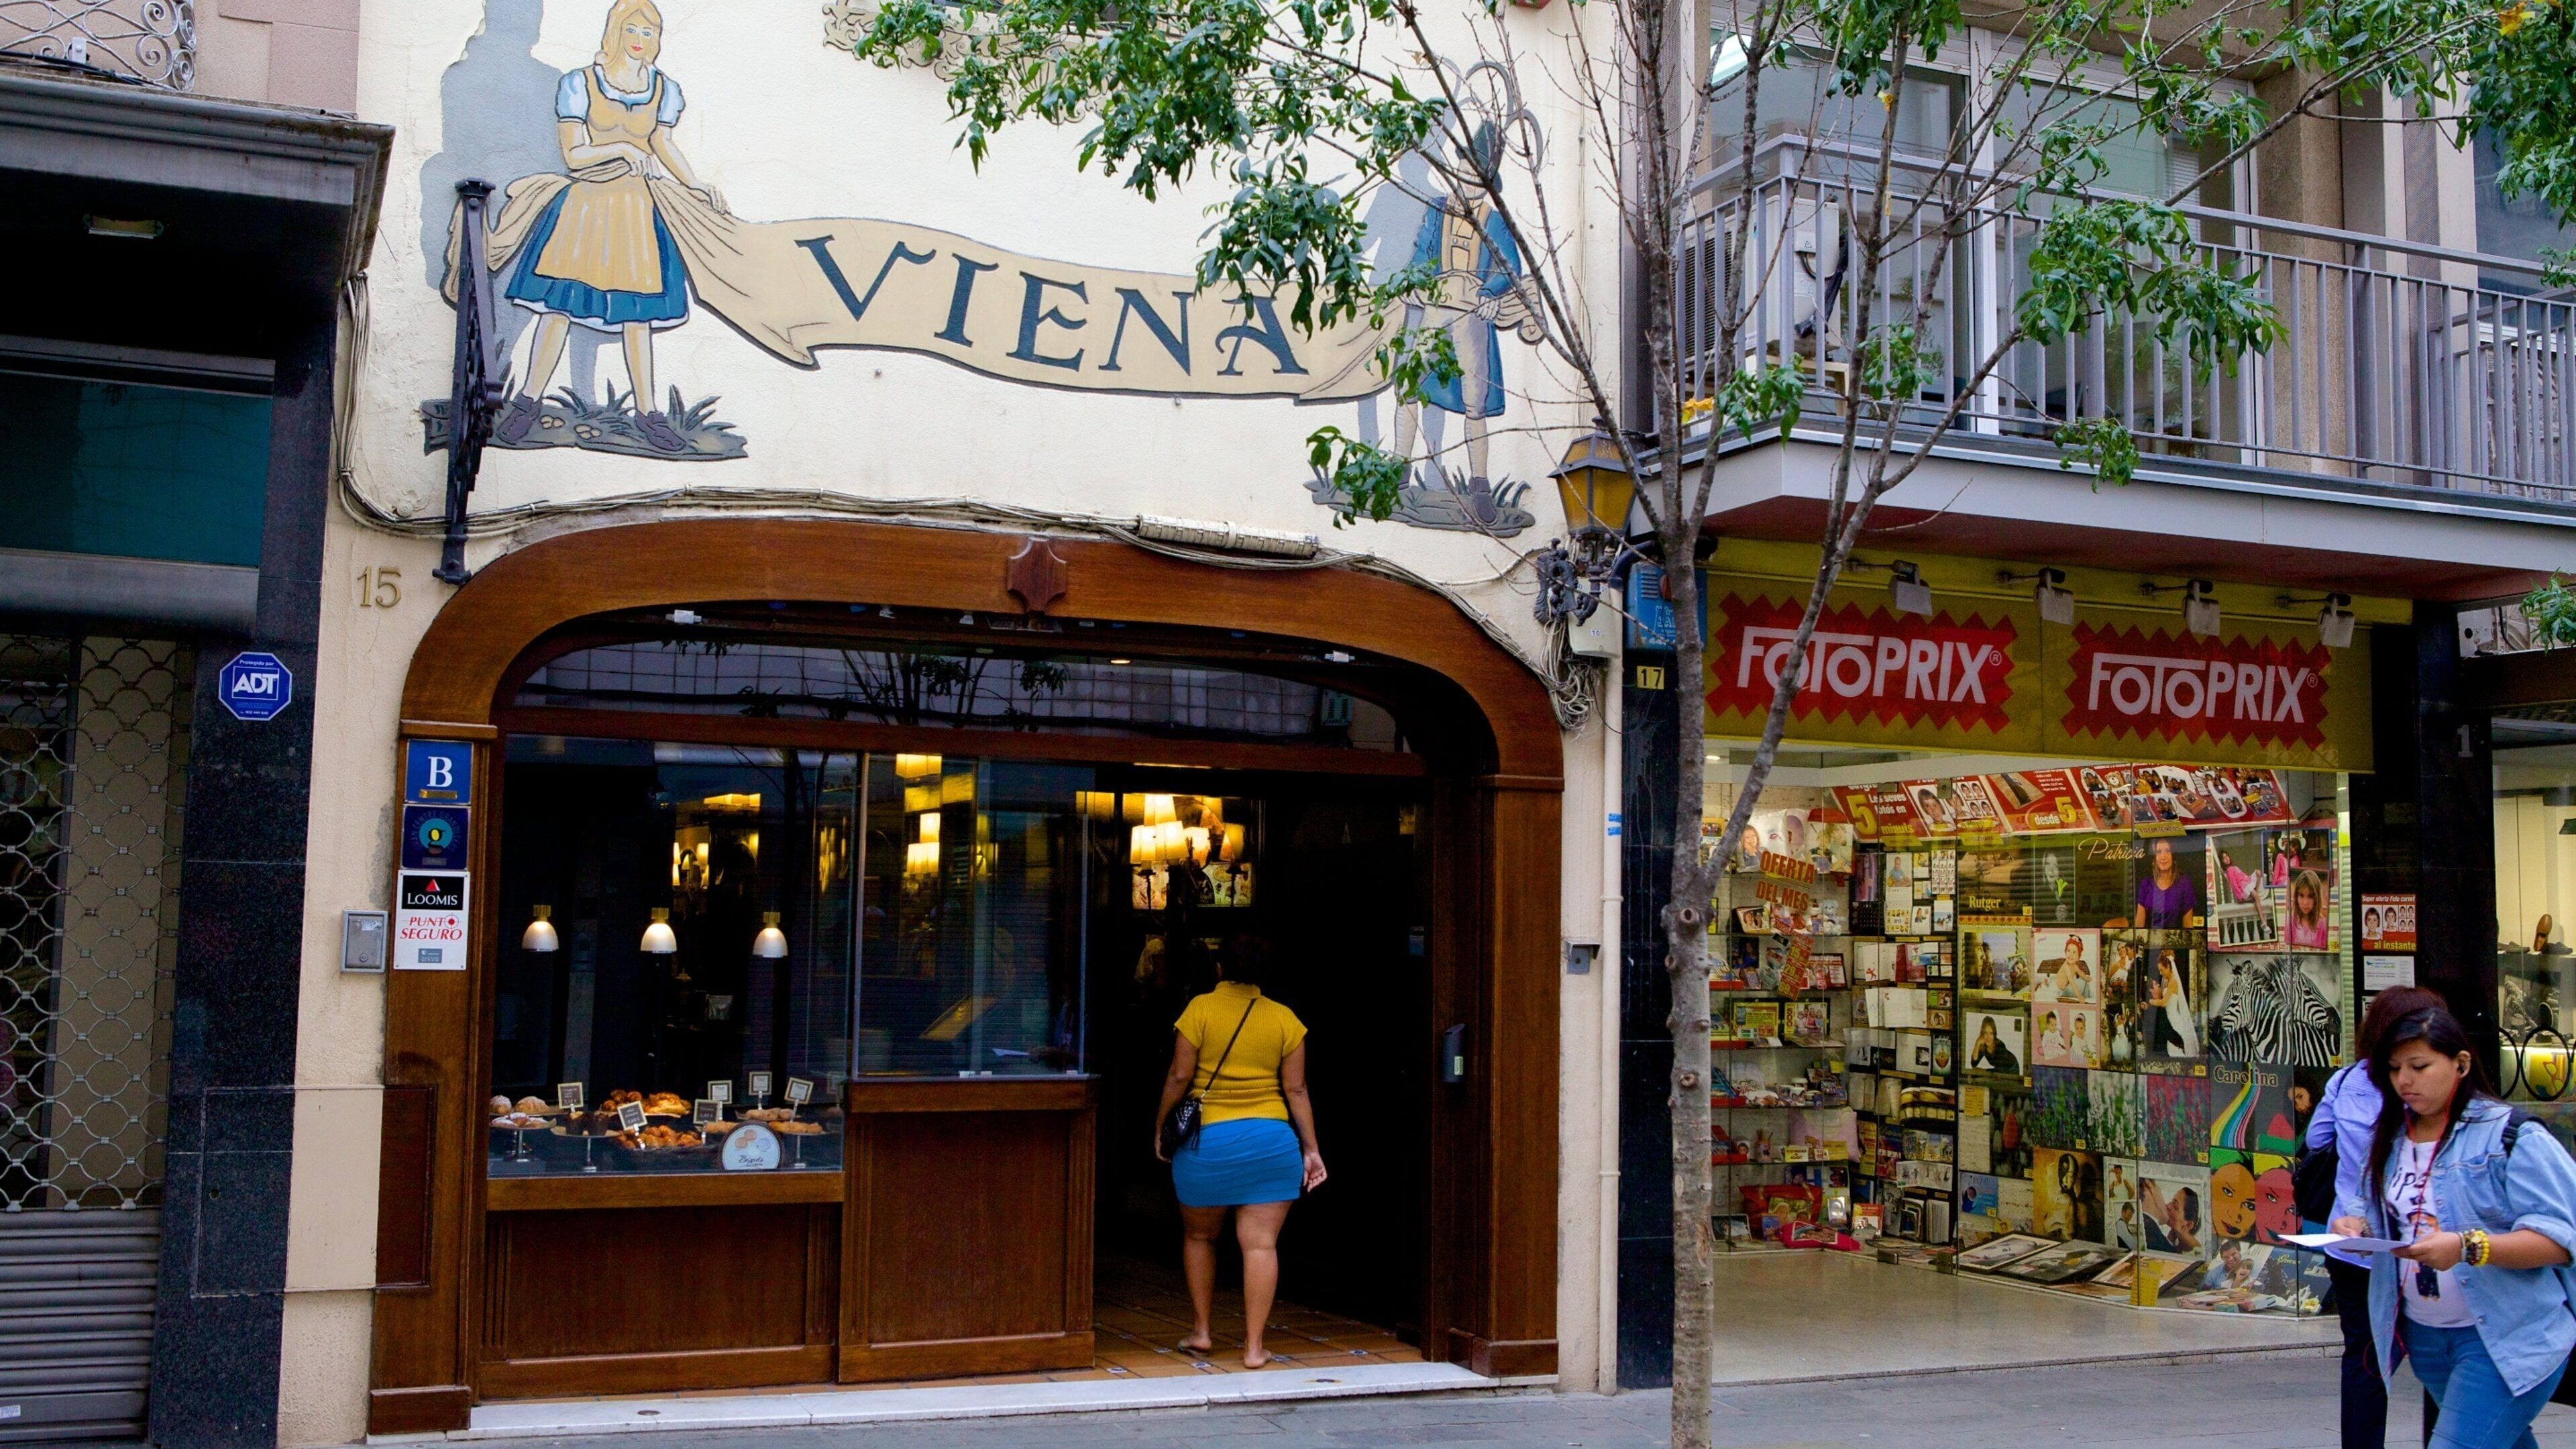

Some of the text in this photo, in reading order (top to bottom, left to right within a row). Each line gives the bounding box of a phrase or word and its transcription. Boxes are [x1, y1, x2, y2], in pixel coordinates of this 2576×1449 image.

[794, 234, 1309, 376] VIENA
[358, 564, 402, 607] 15
[233, 673, 279, 694] ADT
[1641, 669, 1661, 687] 17
[427, 756, 453, 788] B
[1883, 794, 1907, 803] seves
[1896, 805, 1907, 814] en
[1846, 794, 1877, 835] 5
[2034, 814, 2060, 826] desde
[2055, 796, 2077, 823] 5
[1880, 822, 1914, 834] minuts
[2078, 837, 2145, 860] Patricia
[1760, 851, 1814, 884] OFERTA
[407, 893, 458, 906] LOOMIS
[1756, 880, 1809, 912] DEL MES
[1969, 896, 2001, 911] Rutger
[400, 928, 462, 941] SEGURO
[2374, 940, 2416, 949] al instante
[2214, 1064, 2278, 1087] Carolina
